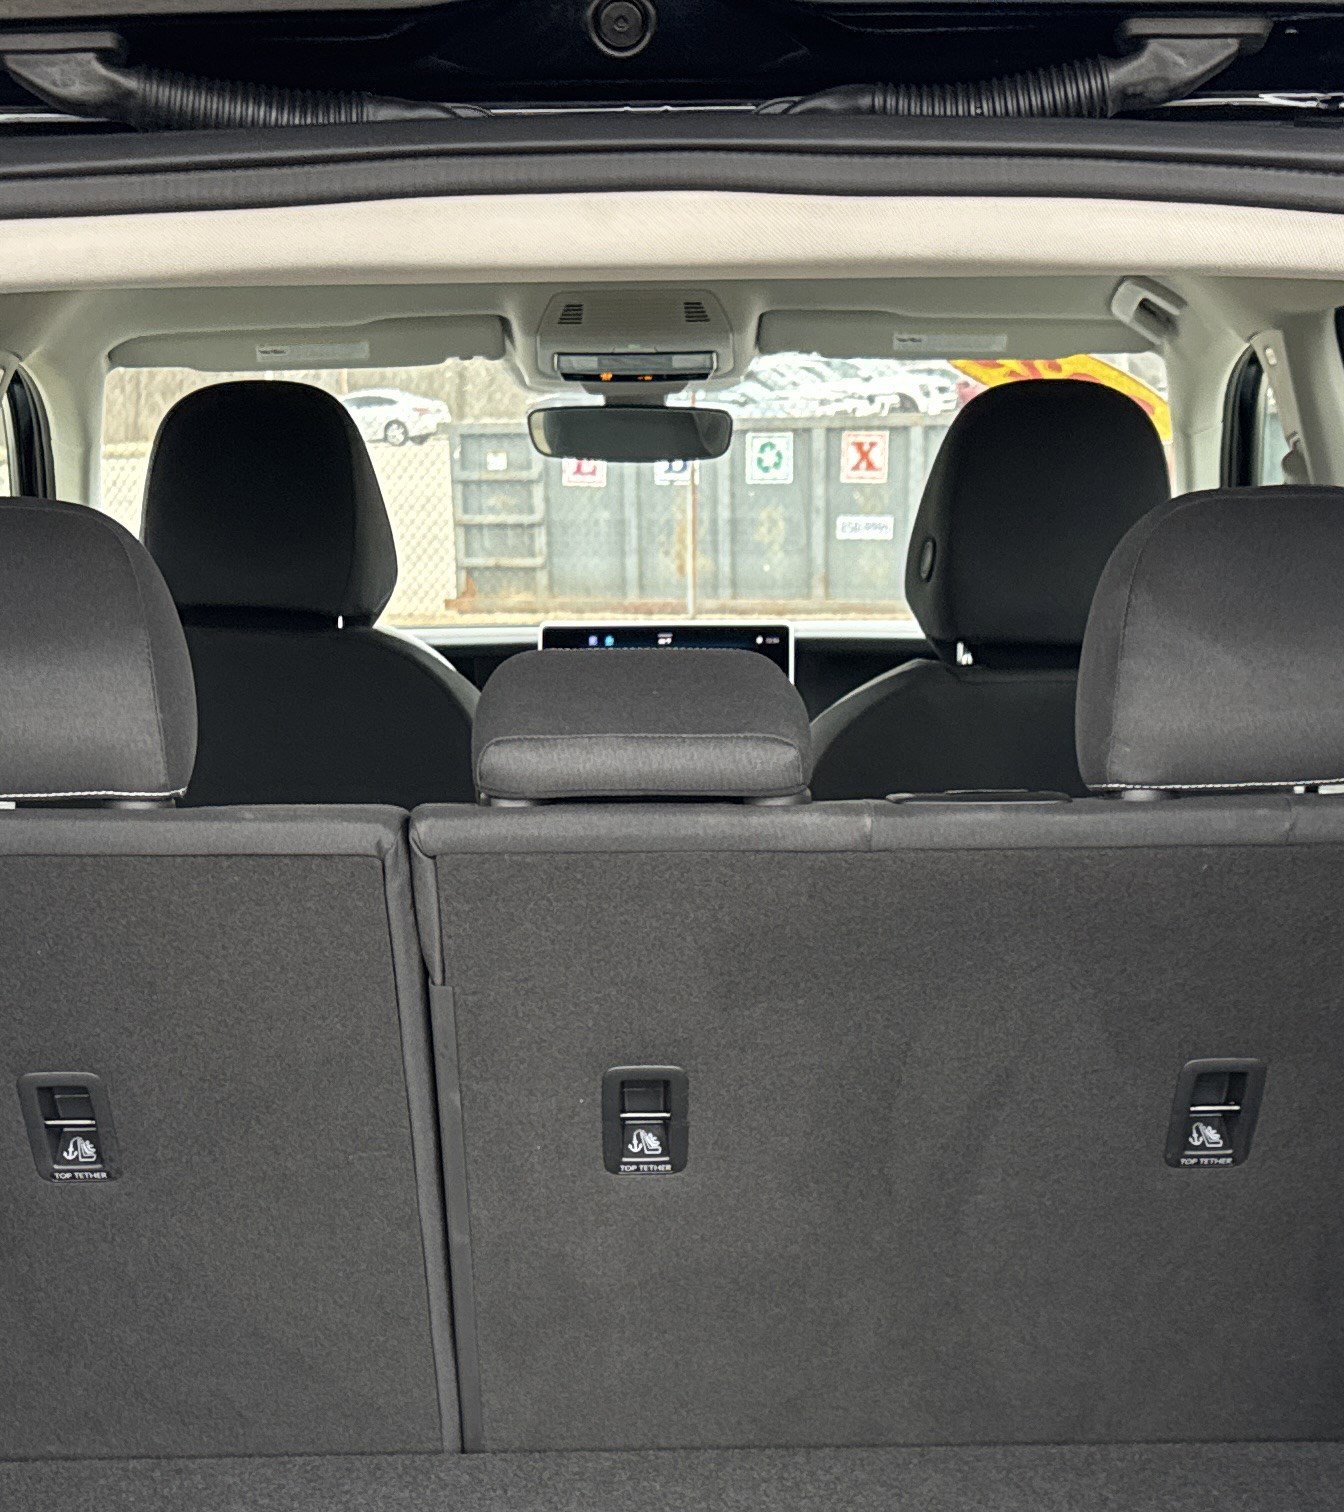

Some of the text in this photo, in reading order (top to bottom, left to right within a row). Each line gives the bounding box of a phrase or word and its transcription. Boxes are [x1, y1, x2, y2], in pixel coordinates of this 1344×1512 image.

[850, 440, 883, 472] X
[1180, 1157, 1233, 1165] TOP TETHER
[619, 1164, 672, 1172] TOP TETHER
[53, 1171, 108, 1180] TOP TETHER
